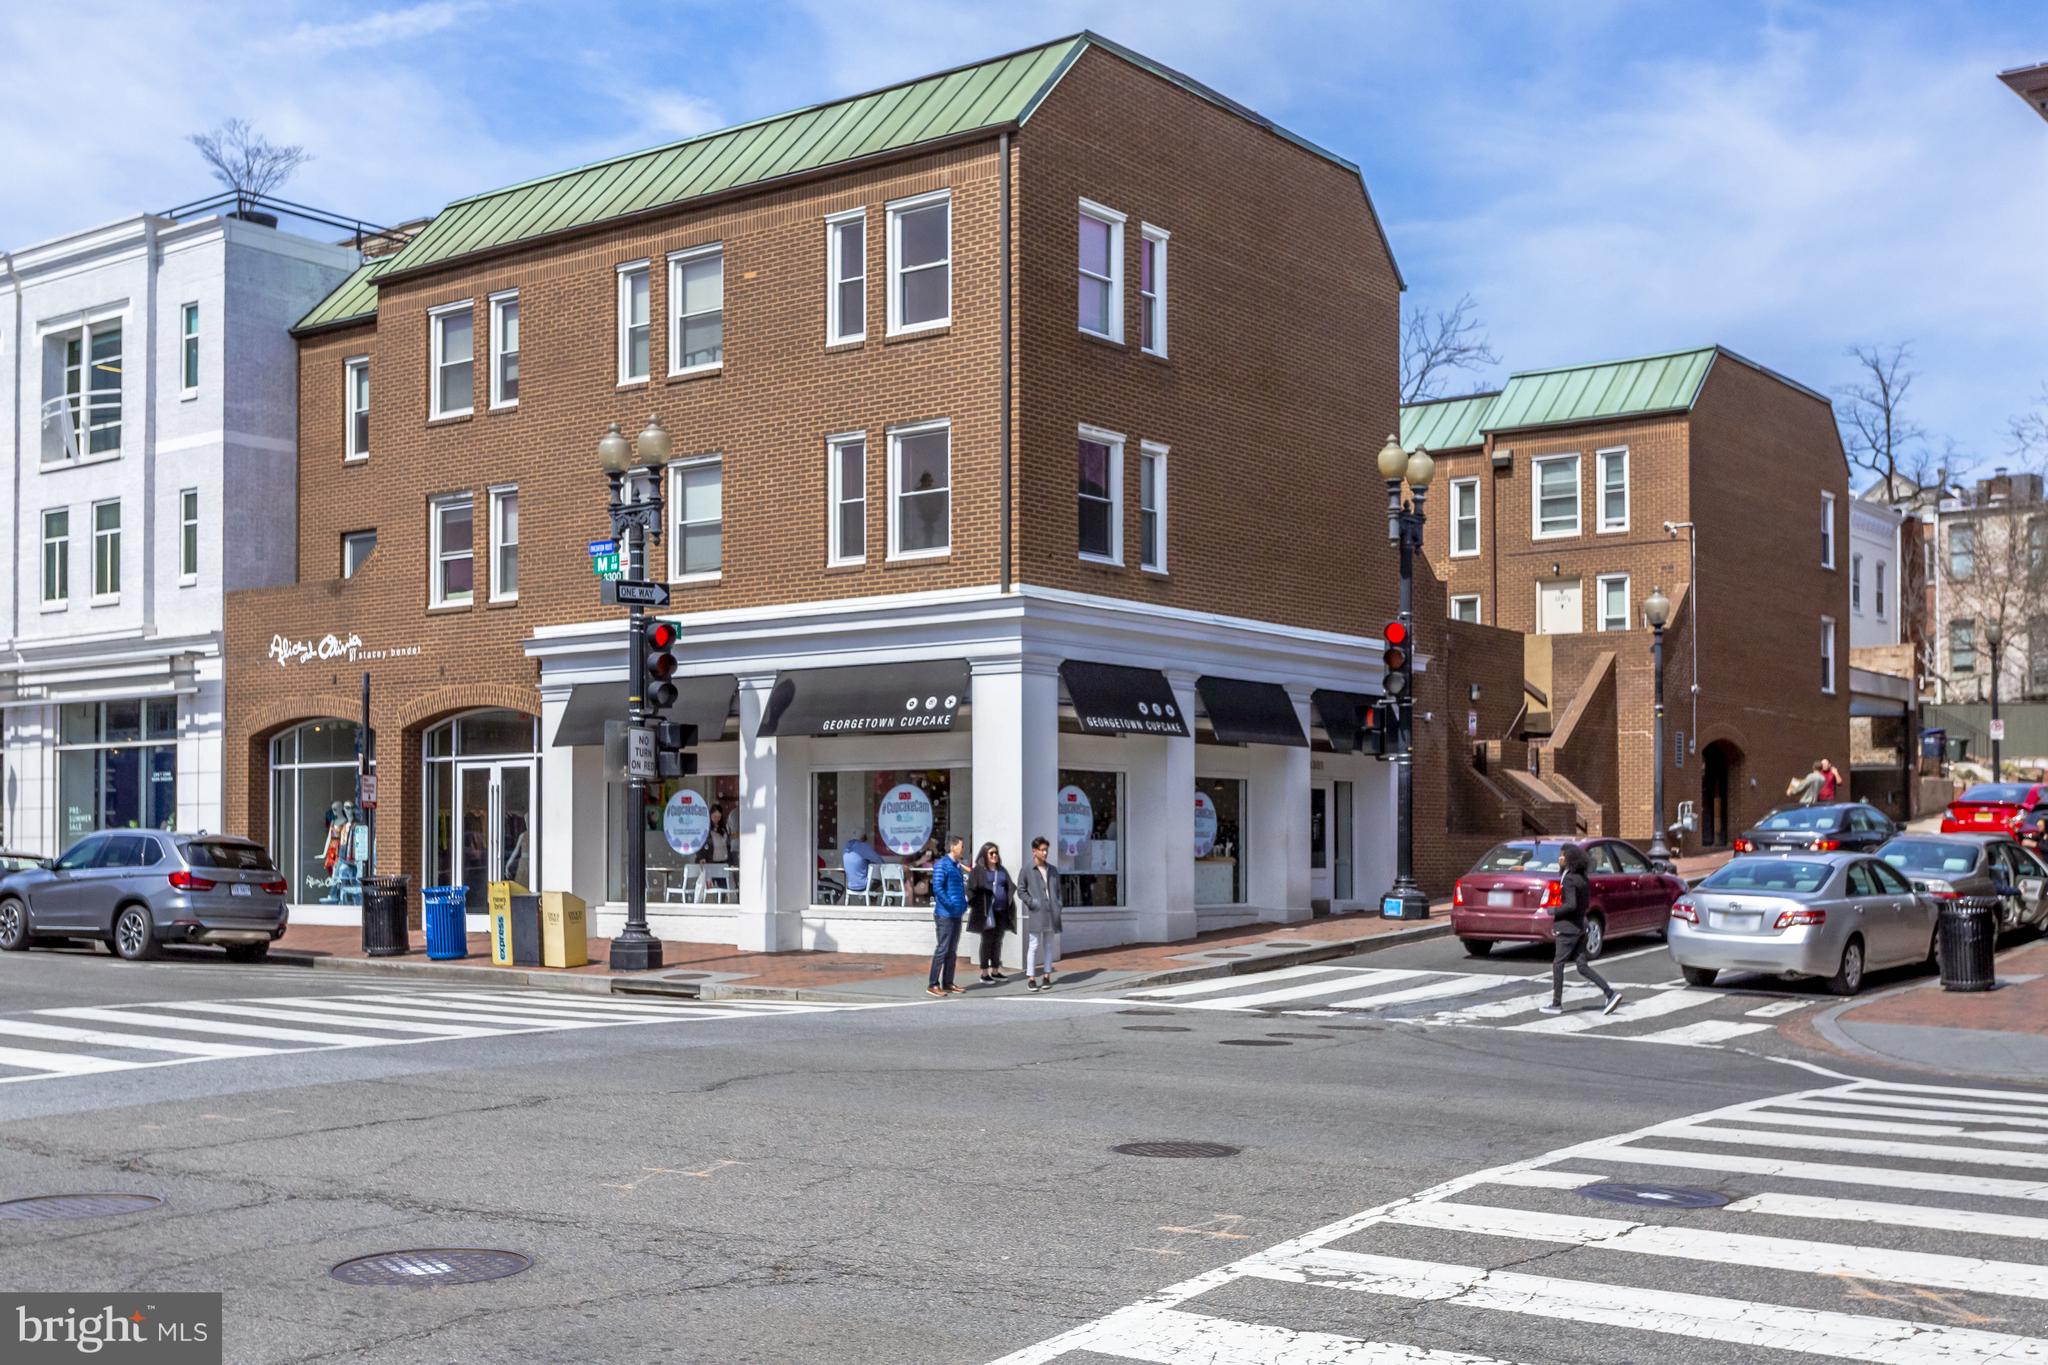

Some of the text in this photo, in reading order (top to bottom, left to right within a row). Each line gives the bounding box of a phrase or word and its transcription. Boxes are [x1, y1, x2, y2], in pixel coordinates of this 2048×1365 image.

[597, 557, 608, 572] M
[620, 587, 654, 599] ONE WAY
[822, 714, 951, 730] GEORGETOWN CUPCAKE
[1086, 716, 1182, 733] GEORGETOWN CUPCAKE
[638, 735, 649, 746] NO
[635, 747, 652, 758] TURN
[631, 760, 656, 771] ON RED
[497, 915, 506, 961] express
